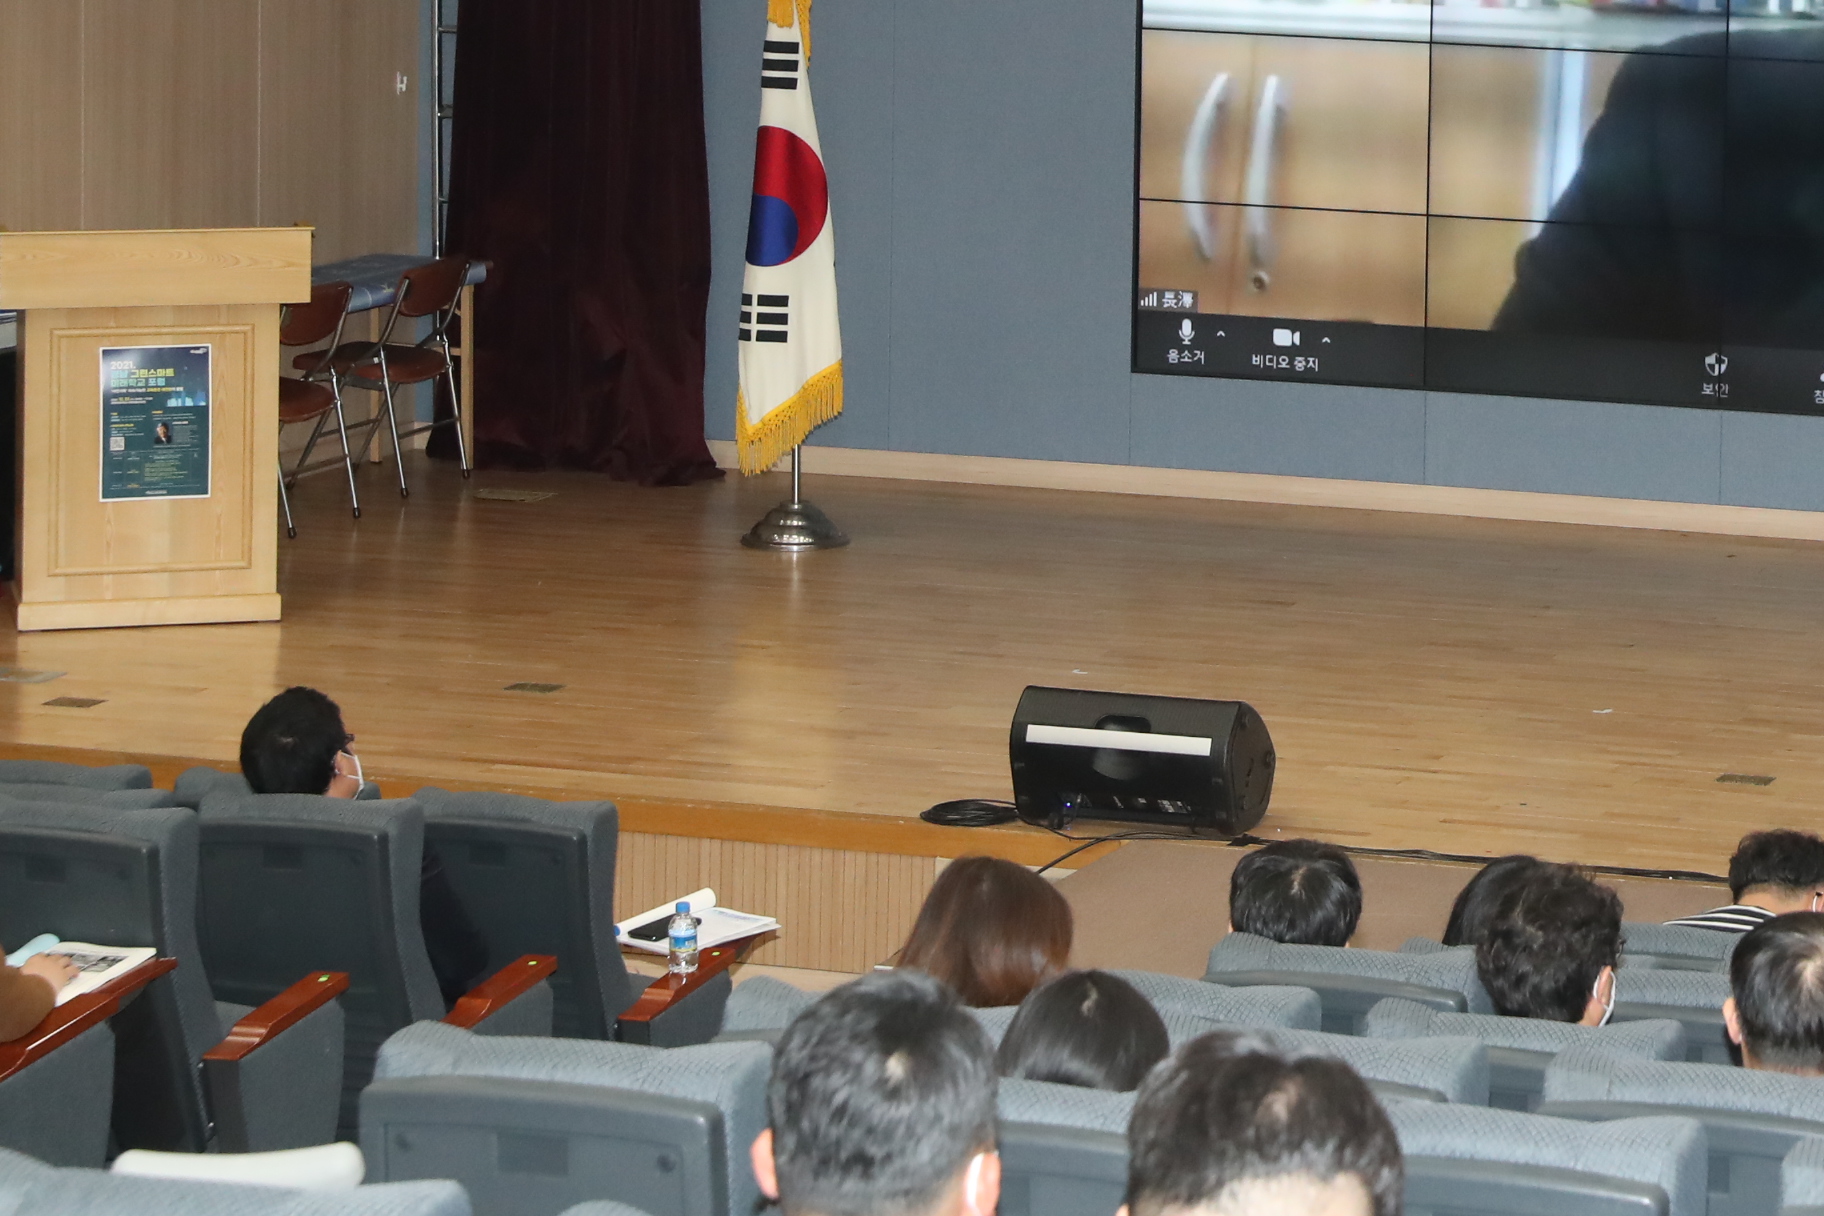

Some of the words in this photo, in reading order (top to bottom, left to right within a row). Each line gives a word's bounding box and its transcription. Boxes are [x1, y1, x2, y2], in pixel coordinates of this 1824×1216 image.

[1166, 348, 1206, 365] 음소거
[1251, 353, 1291, 370] 비디오
[1293, 356, 1319, 372] 중지
